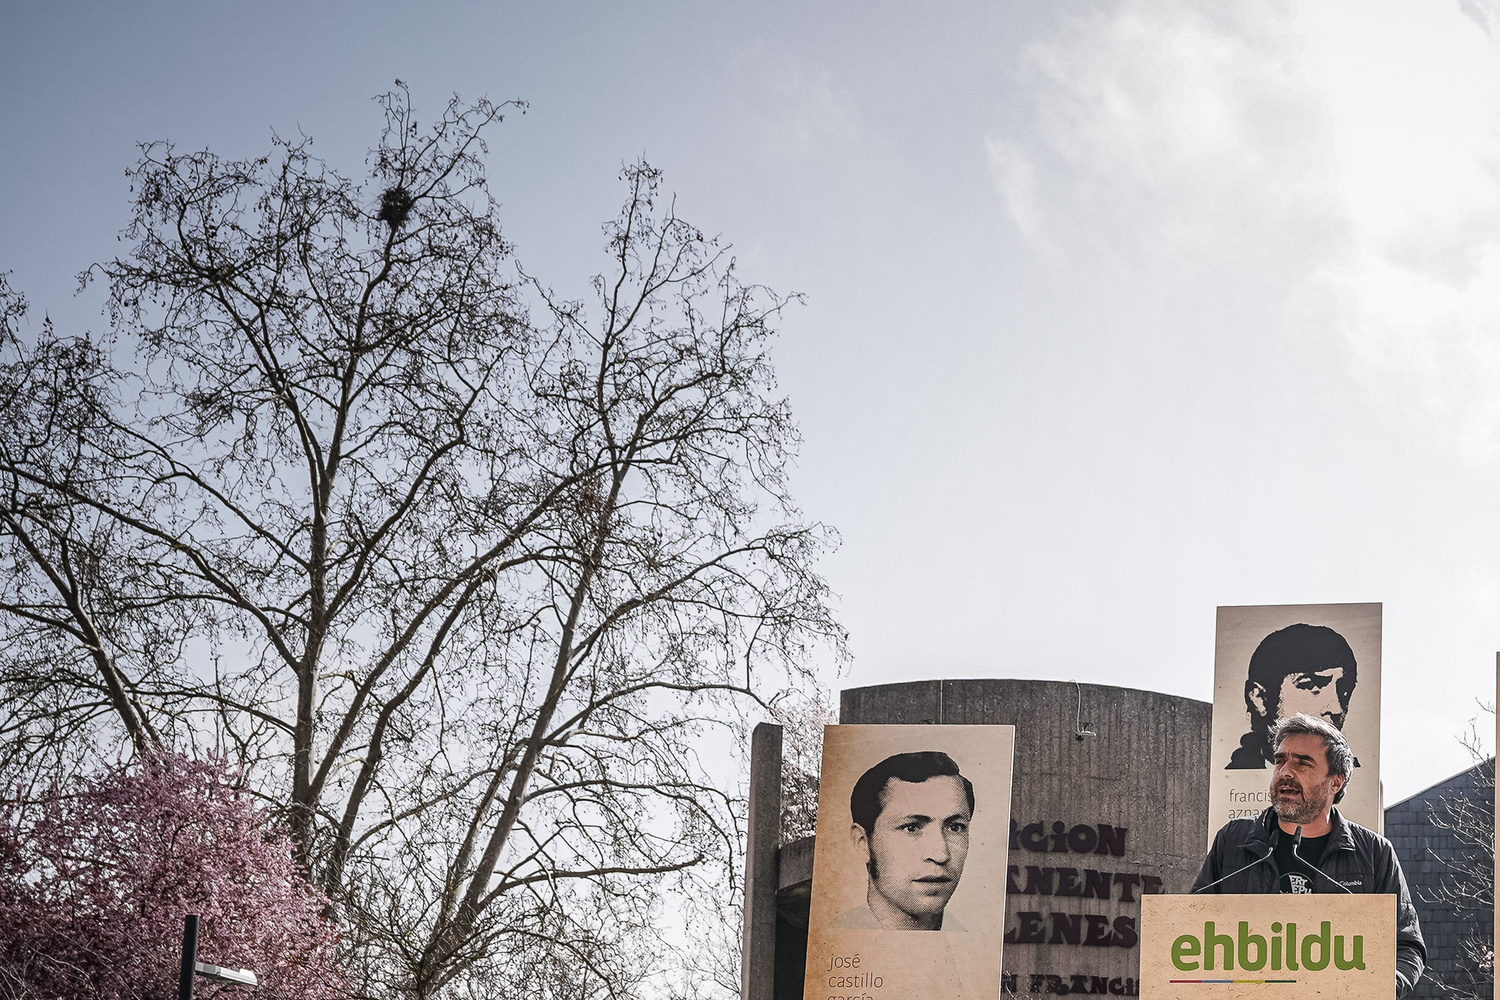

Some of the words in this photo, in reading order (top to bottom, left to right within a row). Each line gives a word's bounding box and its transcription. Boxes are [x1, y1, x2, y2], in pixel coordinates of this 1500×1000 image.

[1228, 808, 1265, 819] azna
[1170, 921, 1366, 972] ehbildu
[827, 953, 861, 972] josé
[828, 972, 884, 989] castillo
[1030, 974, 1139, 997] FRANCi
